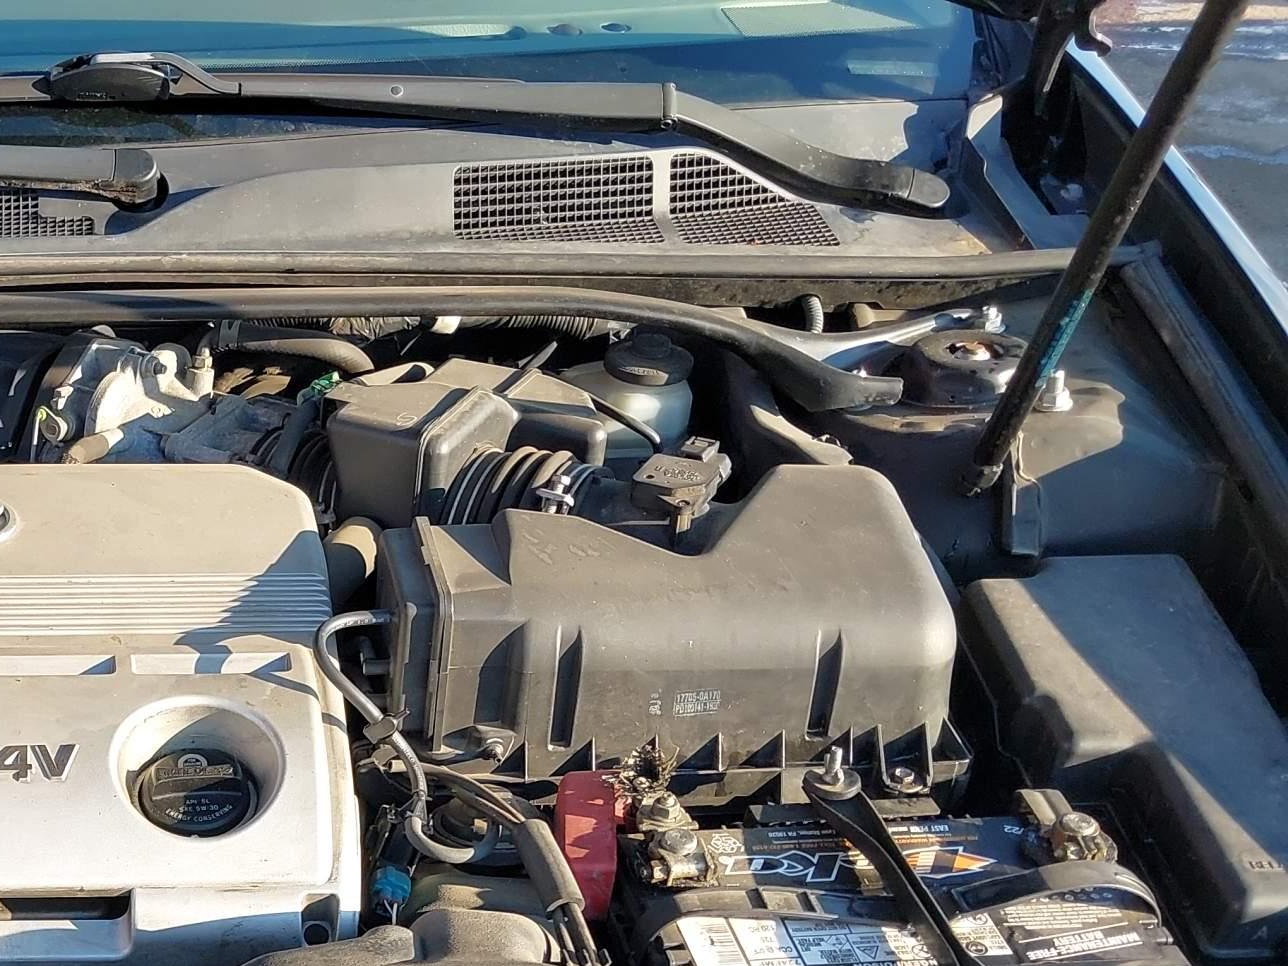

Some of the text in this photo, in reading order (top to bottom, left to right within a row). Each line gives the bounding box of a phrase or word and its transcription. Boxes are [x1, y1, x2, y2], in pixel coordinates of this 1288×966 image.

[165, 804, 233, 823] ENERGY CONSERVING
[931, 824, 949, 833] EAST
[1025, 931, 1141, 961] MAINTENANCE-FREE
[1052, 929, 1105, 947] BATTERY
